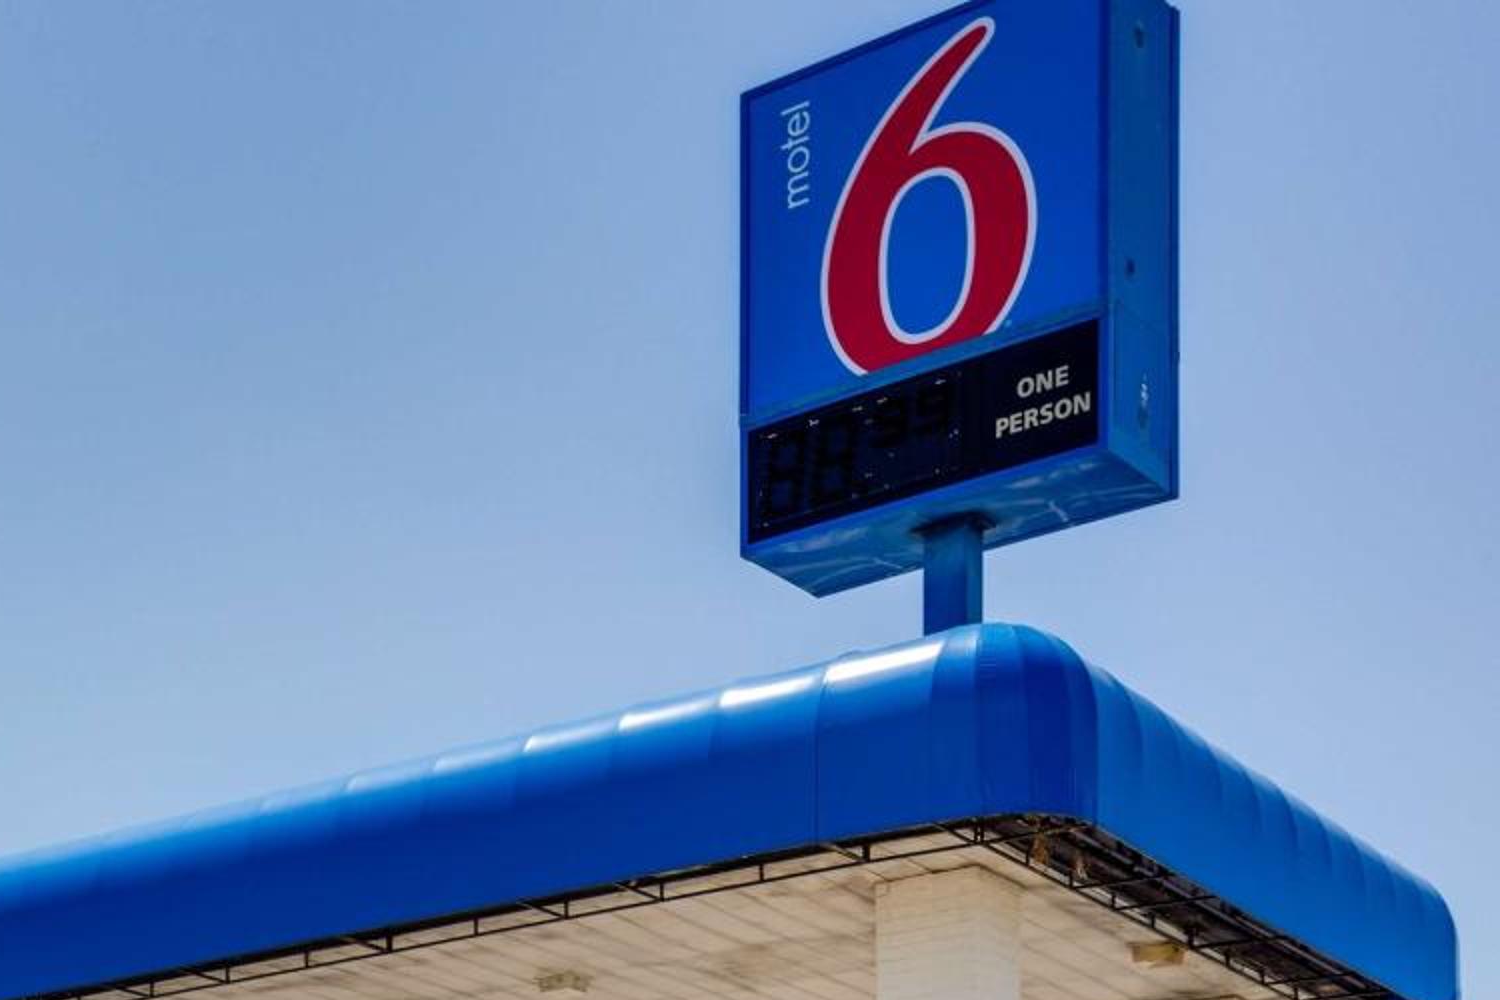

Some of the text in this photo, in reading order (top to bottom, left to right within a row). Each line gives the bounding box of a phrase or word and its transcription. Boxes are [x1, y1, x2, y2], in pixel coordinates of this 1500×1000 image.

[781, 101, 810, 208] motel
[820, 16, 1037, 376] 6
[995, 392, 1091, 439] PERSON
[1016, 365, 1069, 398] ONE
